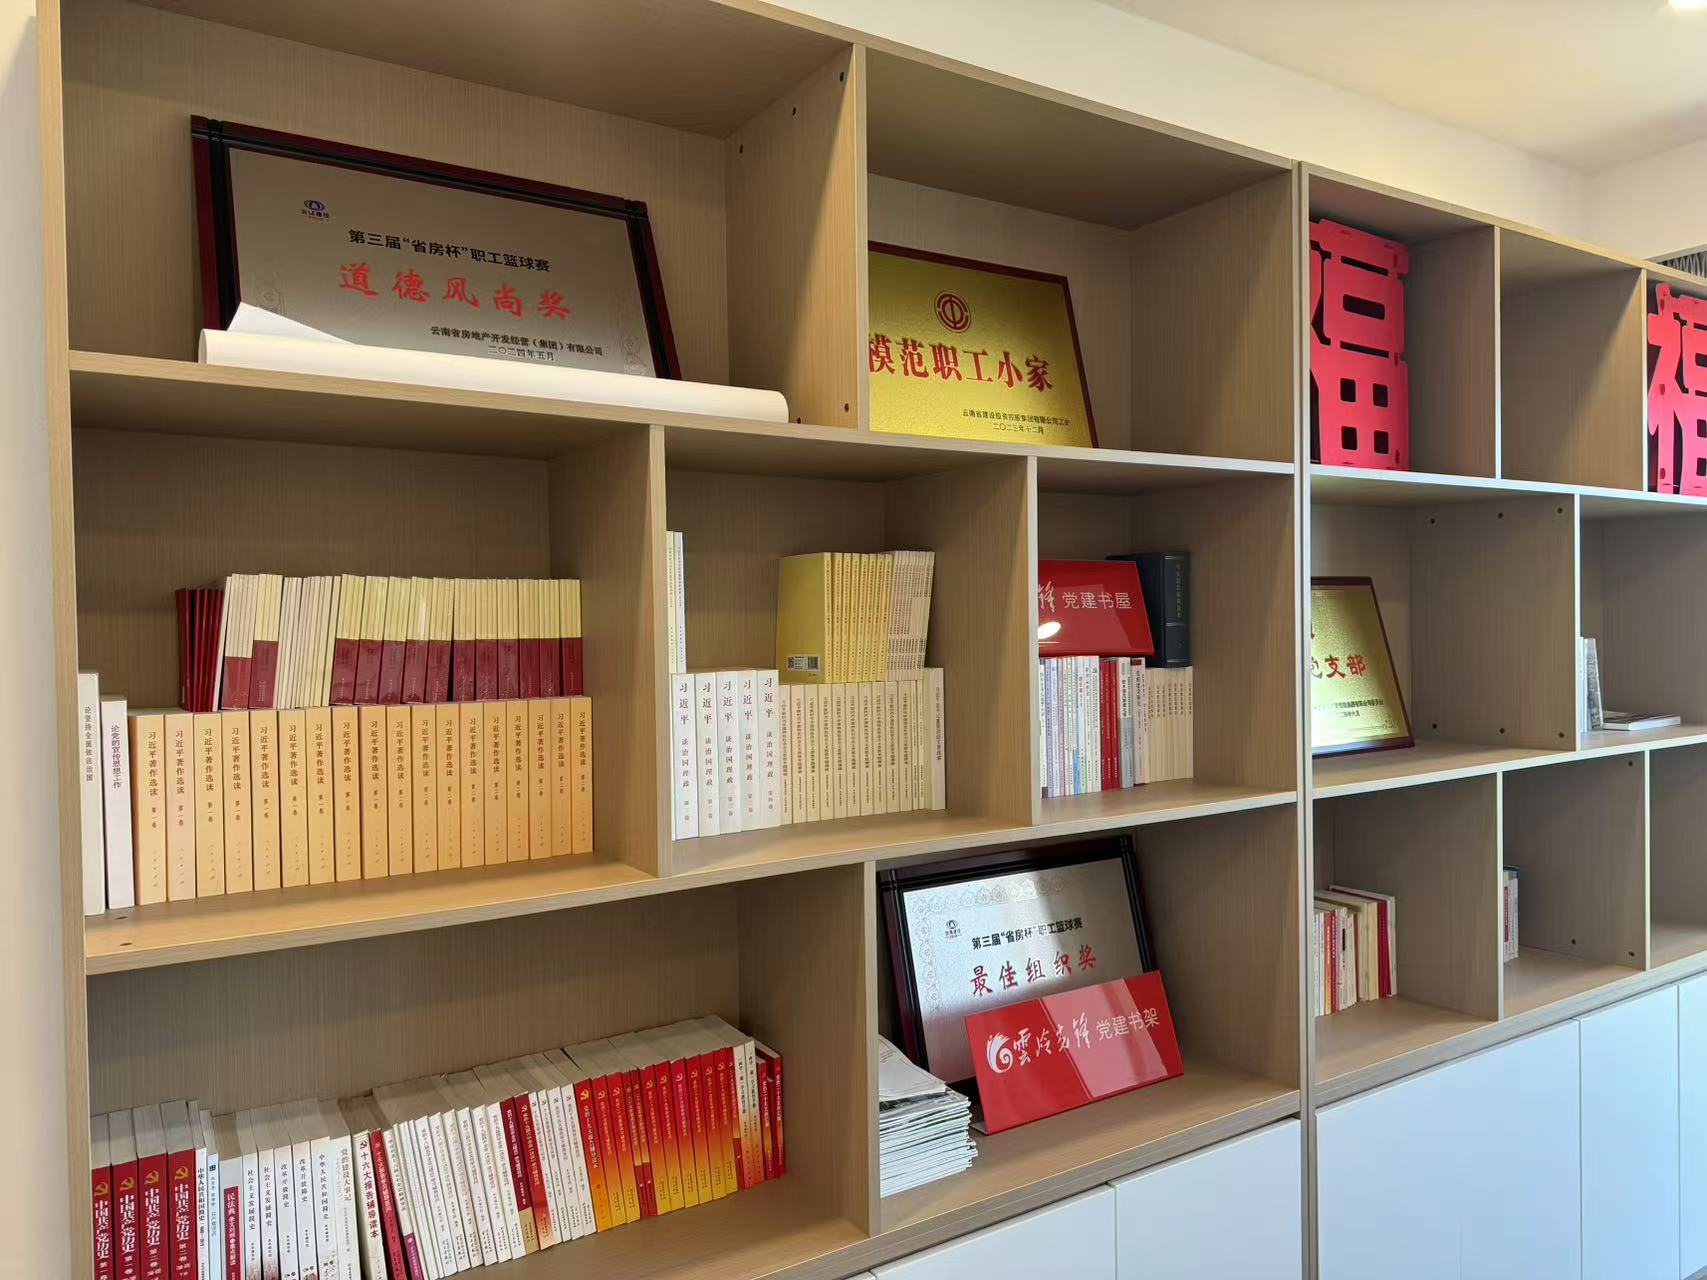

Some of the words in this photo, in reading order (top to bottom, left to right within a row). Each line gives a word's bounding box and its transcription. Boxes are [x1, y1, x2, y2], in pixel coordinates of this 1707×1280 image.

[339, 262, 571, 320] 道德风尚奖
[868, 332, 1053, 392] 模范职工小家
[1062, 591, 1132, 610] 党建书屋
[680, 683, 689, 725] 习近平
[703, 682, 712, 724] 习近平
[723, 681, 733, 723] 习近平
[743, 679, 753, 720] 习近平
[764, 677, 774, 718] 习近平
[111, 724, 122, 789] 论党的宣传思想工作
[149, 732, 158, 796] 习近平著作选读
[176, 730, 184, 794] 习近平著作选读
[204, 729, 214, 791] 习近平著作选读
[232, 728, 241, 790] 习近平著作选读
[260, 726, 270, 788] 习近平著作选读
[289, 725, 298, 785] 习近平著作选读
[316, 724, 324, 784] 习近平著作选读
[343, 722, 351, 781] 习近平著作选读
[371, 721, 379, 780] 习近平著作选读
[681, 738, 689, 787] 谈治国理政
[705, 737, 713, 786] 谈治国理政
[725, 735, 733, 784] 谈治国理政
[745, 733, 753, 781] 谈治国理政
[766, 731, 774, 778] 谈治国理政
[970, 944, 1096, 997] 最佳组织奖
[1096, 1007, 1160, 1041] 党建书架
[247, 1169, 255, 1230] 社会主义发展简史
[264, 1166, 272, 1227] 社会主义发展简史
[281, 1163, 289, 1208] 改革开放简史
[299, 1158, 308, 1202] 改革开放简史
[319, 1154, 329, 1220] 中华人民共和国简史
[361, 1152, 379, 1239] 十六大报告辅导读本
[95, 1200, 110, 1260] 中国共产党历史
[120, 1194, 135, 1254] 中国共产党历史
[145, 1188, 160, 1247] 中国共产党历史
[175, 1184, 189, 1242] 中国共产党历史
